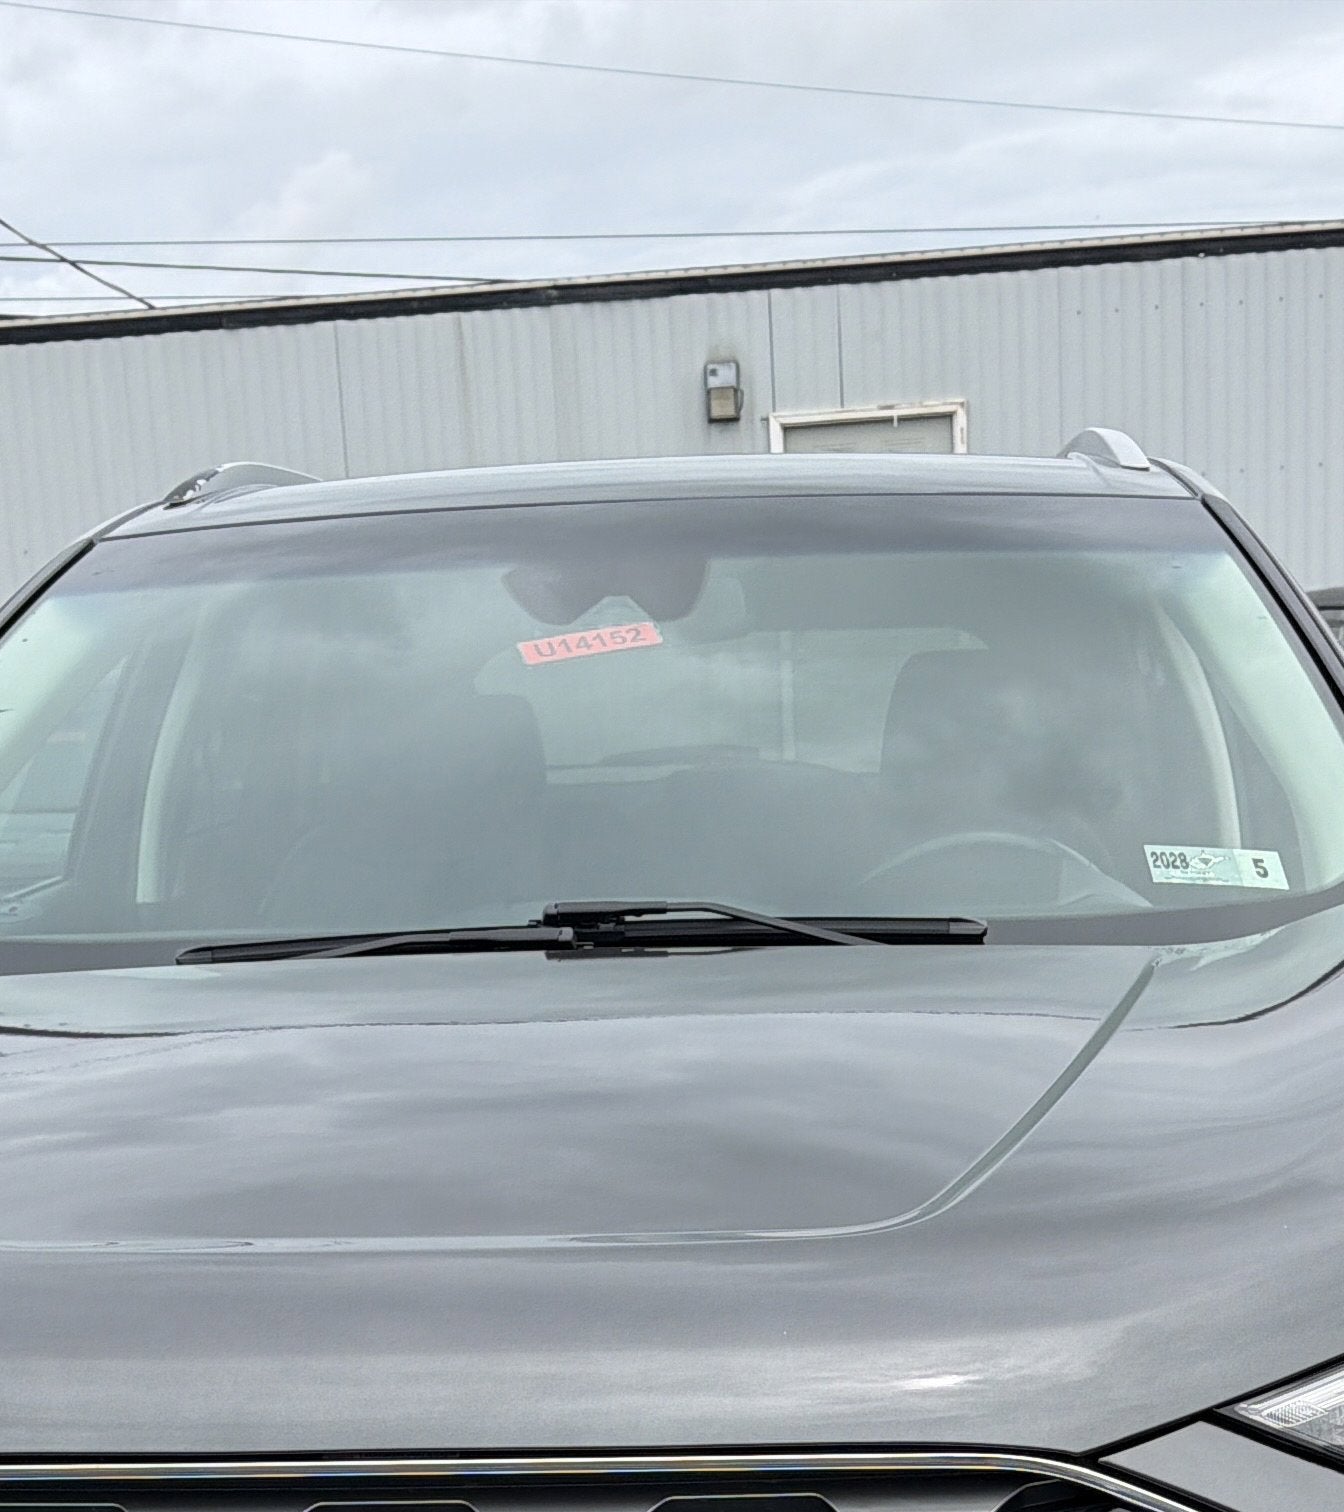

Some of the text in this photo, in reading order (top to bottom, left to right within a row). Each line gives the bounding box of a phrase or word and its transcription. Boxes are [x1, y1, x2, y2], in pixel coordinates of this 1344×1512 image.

[532, 627, 647, 658] U14152
[1150, 850, 1190, 871] 2028
[1250, 857, 1270, 879] 5
